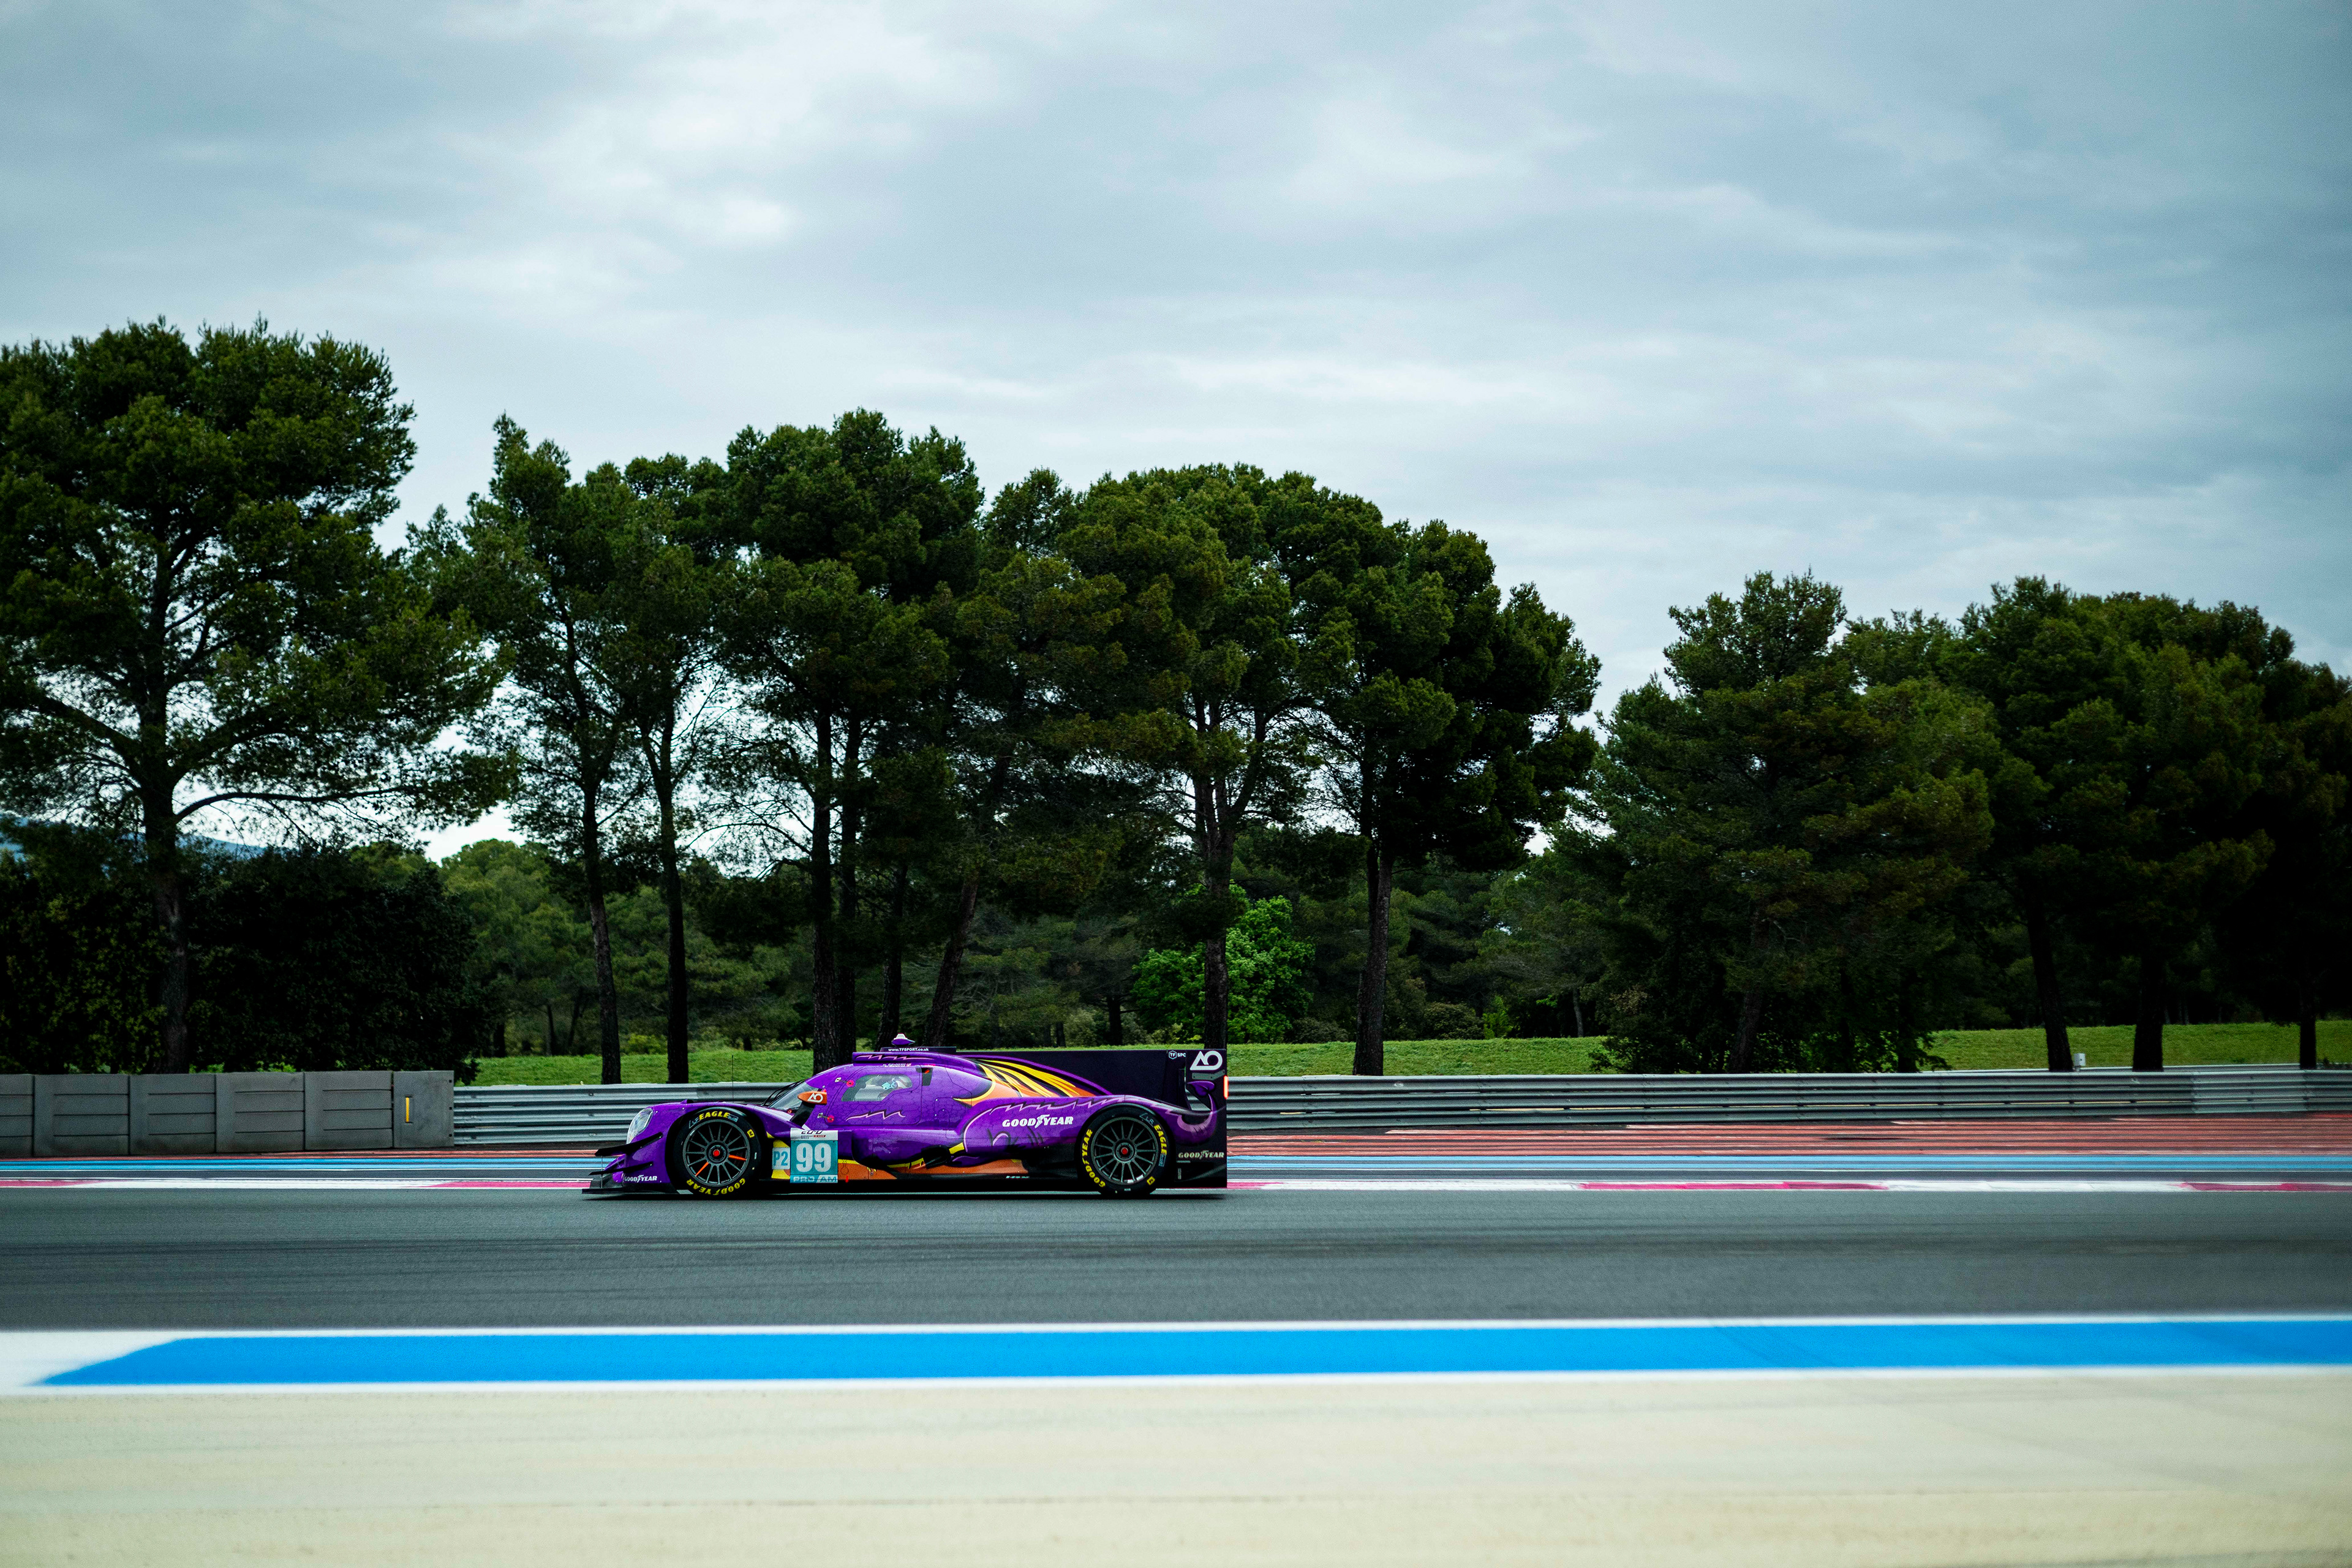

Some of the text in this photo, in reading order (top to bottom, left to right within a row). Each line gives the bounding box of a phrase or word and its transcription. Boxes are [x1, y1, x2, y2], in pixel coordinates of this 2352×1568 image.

[699, 1110, 731, 1120] EAGLE
[1153, 1124, 1167, 1155] EAGLE
[773, 1151, 788, 1166] P2
[796, 1143, 831, 1172] 99
